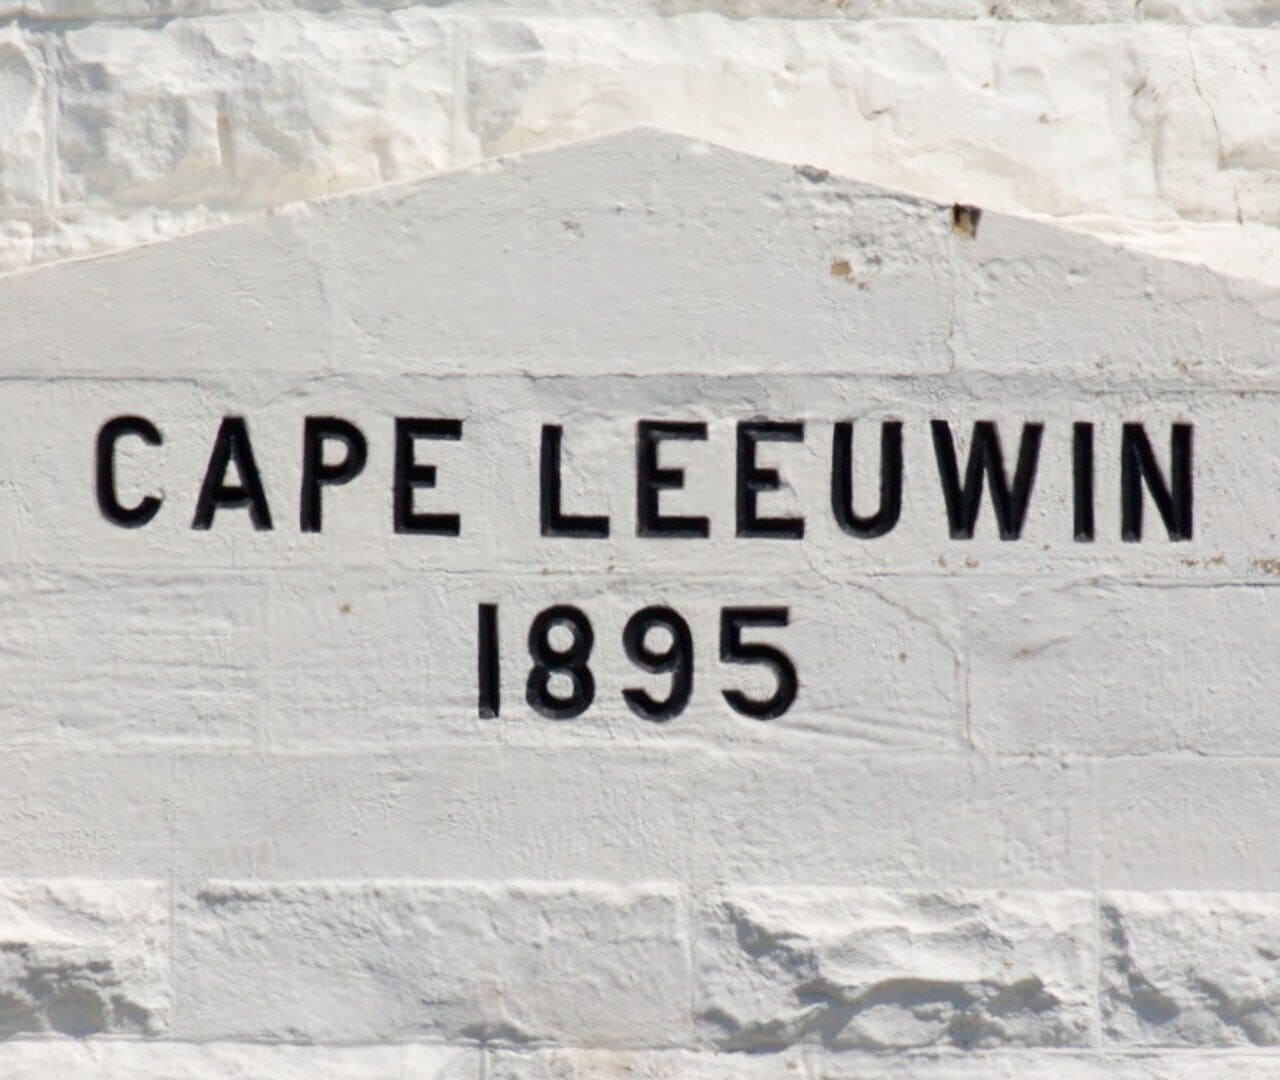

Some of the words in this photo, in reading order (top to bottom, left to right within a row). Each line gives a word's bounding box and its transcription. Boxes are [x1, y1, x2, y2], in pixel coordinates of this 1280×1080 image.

[96, 415, 463, 537] CAPE
[539, 419, 1195, 542] LEEUWIN
[478, 603, 799, 722] 1895
